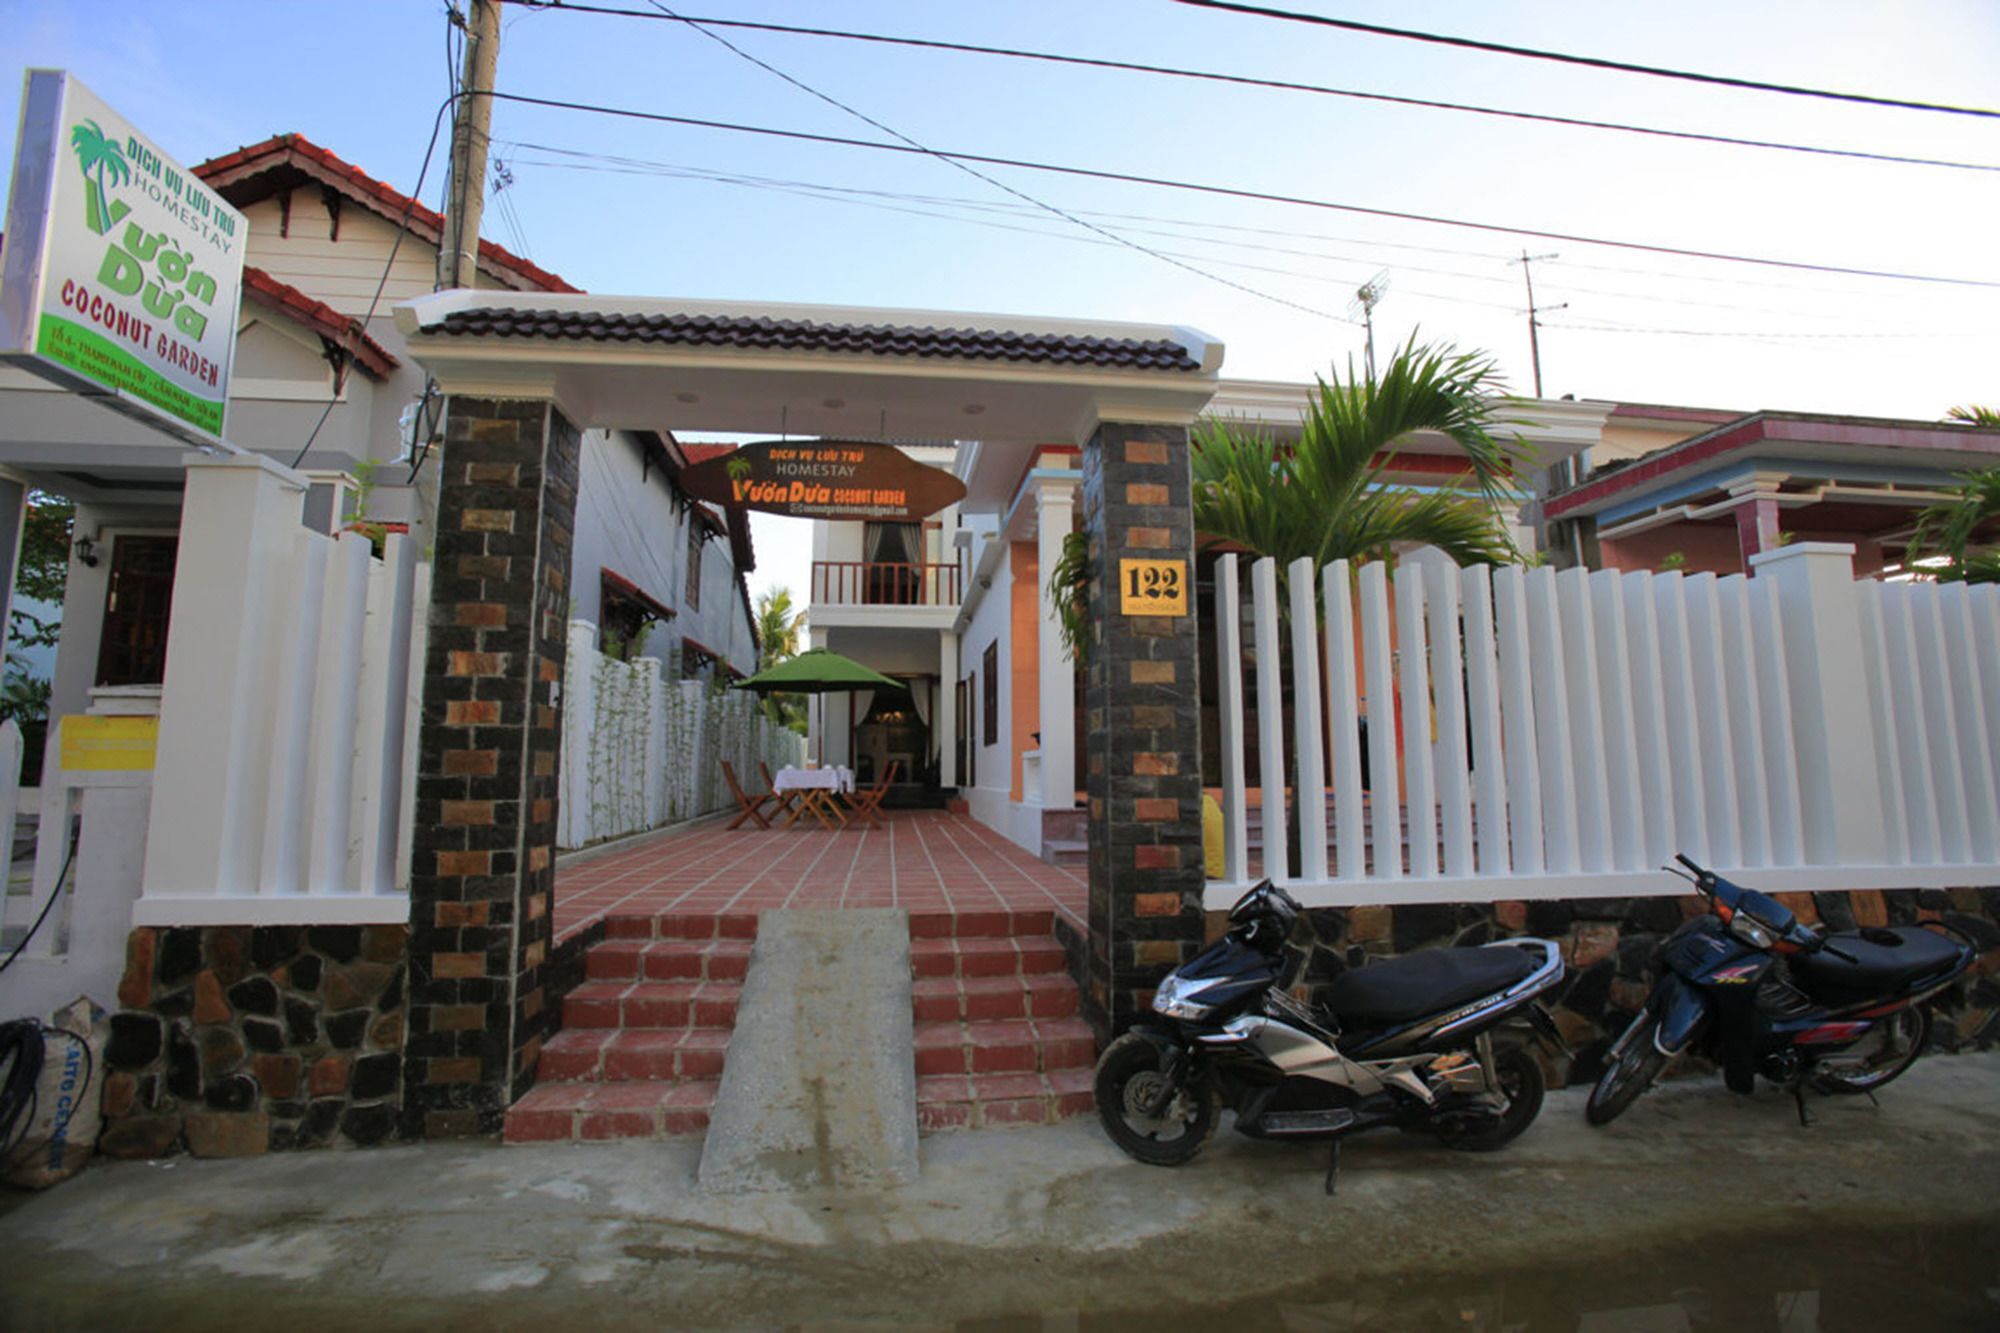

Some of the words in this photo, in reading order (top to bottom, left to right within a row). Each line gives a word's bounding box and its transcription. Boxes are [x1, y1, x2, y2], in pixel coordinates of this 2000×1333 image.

[127, 135, 161, 180] DỊCH
[164, 165, 183, 199] VỤ
[186, 177, 211, 218] LƯU
[213, 204, 236, 238] TRÚ
[133, 167, 232, 255] HOMESTAY
[85, 174, 218, 307] Vườn
[61, 277, 153, 348] COCONUT
[97, 241, 209, 343] Dừa
[157, 331, 220, 389] GARDEN
[776, 463, 857, 477] HOMESTAY
[1127, 566, 1180, 600] 122
